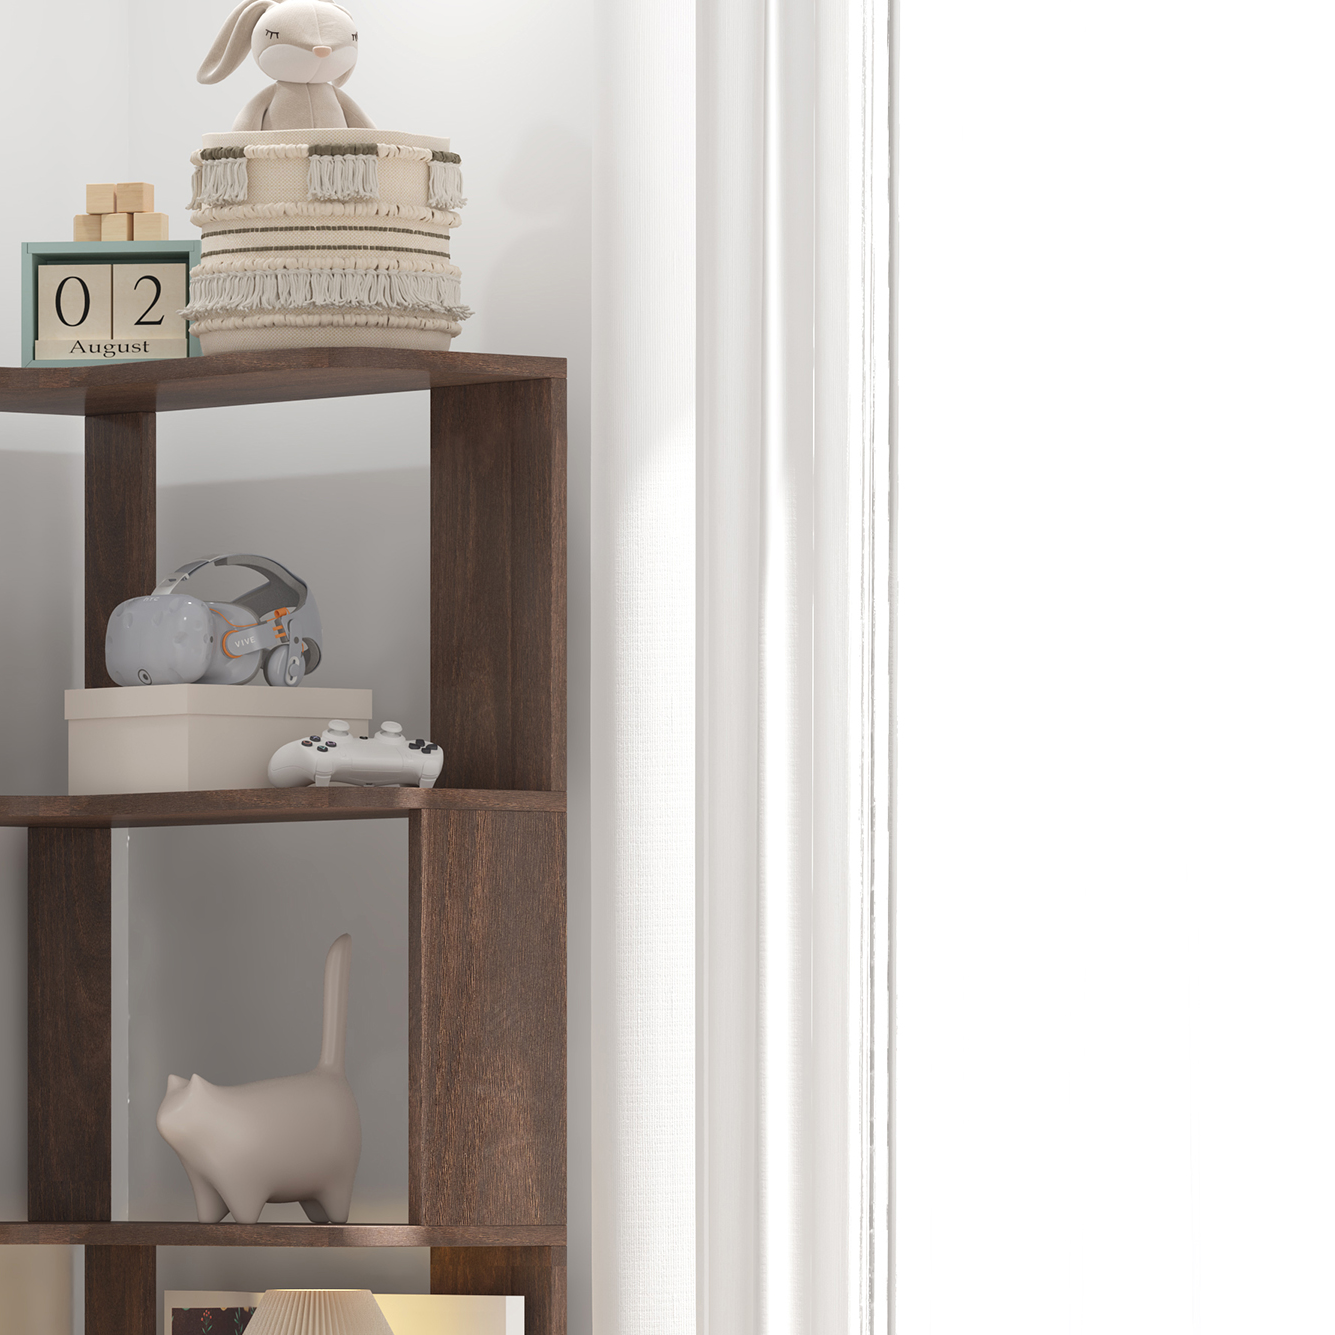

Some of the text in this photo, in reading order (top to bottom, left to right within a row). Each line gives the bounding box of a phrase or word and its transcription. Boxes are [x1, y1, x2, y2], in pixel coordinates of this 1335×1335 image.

[55, 275, 165, 327] 0 2
[69, 340, 150, 358] August
